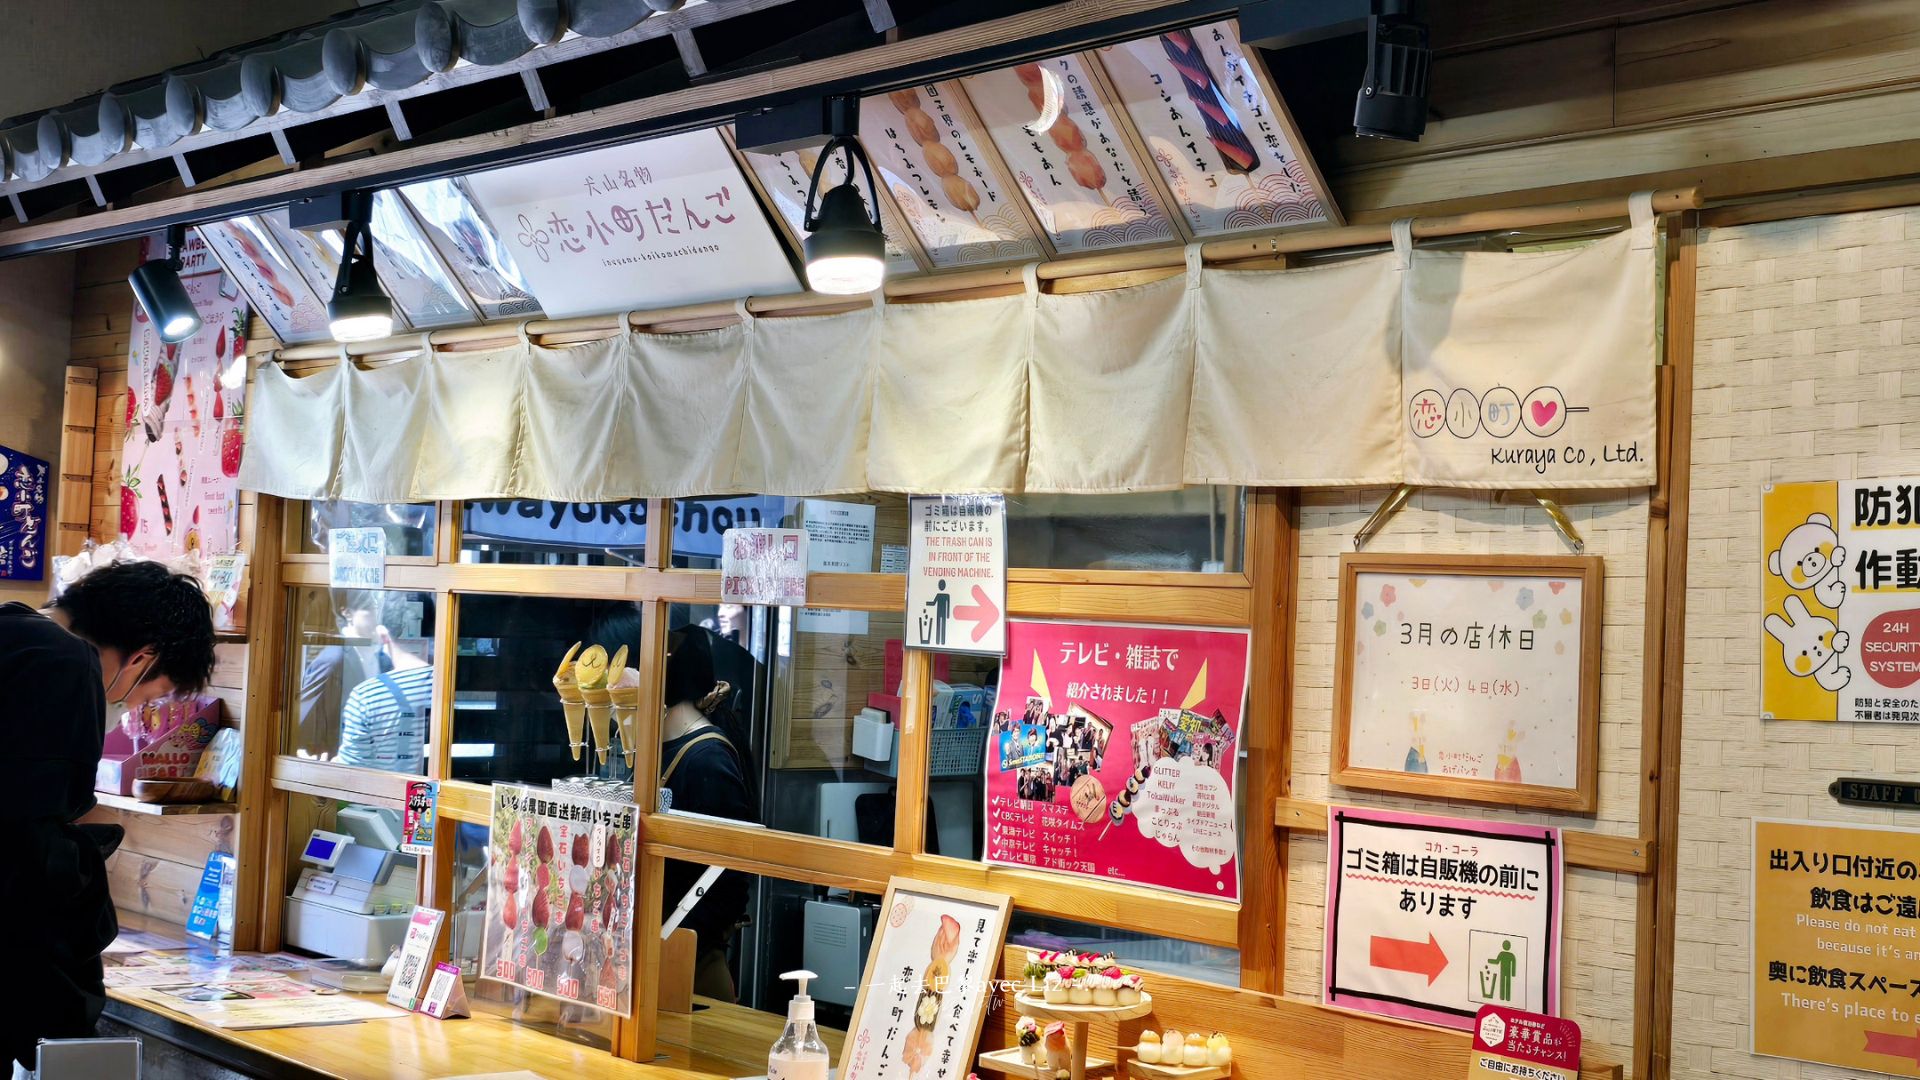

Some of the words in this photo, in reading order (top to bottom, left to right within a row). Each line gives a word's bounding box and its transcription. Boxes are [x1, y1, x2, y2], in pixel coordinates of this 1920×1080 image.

[1211, 27, 1302, 194] あんがイチゴに恋をした
[1150, 73, 1218, 188] コシあんイチゴ
[1022, 125, 1062, 187] ももあん
[584, 166, 653, 197] 犬山名物
[884, 127, 946, 223] はちみつレモン
[547, 186, 736, 253] 恋小町だんご
[1413, 398, 1515, 430] 恋小町
[1491, 446, 1556, 474] Kuraya
[1603, 441, 1645, 463] Ltd.
[925, 504, 992, 517] ゴミ箱は自販機の
[925, 521, 990, 532] 前にございます。
[925, 536, 940, 547] THE
[942, 537, 966, 547] TRASH
[968, 537, 984, 547] CAN
[985, 537, 992, 547] IS
[928, 552, 936, 562] IN
[938, 552, 962, 563] FRONT
[964, 552, 973, 563] OF
[975, 552, 990, 563] THE
[923, 567, 956, 578] VENDING
[957, 568, 994, 578] MACHINE.
[1400, 621, 1534, 650] 3月の店休日
[1883, 622, 1909, 634] 24H
[1060, 641, 1179, 671] テレビ・雑誌で
[1870, 661, 1920, 672] SYSTEM
[1153, 766, 1180, 778] GLITTER
[1850, 783, 1903, 802] STAFF
[500, 794, 632, 831] いなば農園直送新鮮いちご串
[1001, 811, 1035, 824] CBCテレビ
[1041, 803, 1068, 814] スマステ
[1151, 817, 1183, 830] ことりっぷ
[1155, 830, 1180, 842] じゃらん
[1425, 841, 1479, 857] コカ・コーラ
[1346, 847, 1539, 891] ゴミ箱は自販機の前に
[1770, 849, 1920, 880] 出入り口付近の
[1399, 888, 1477, 919] あります
[1810, 887, 1920, 919] 飲食はご遠
[1796, 914, 1840, 930] Please
[1844, 919, 1860, 932] do
[1865, 924, 1888, 935] not
[1893, 926, 1917, 938] eat
[1817, 937, 1872, 955] because
[1905, 950, 1920, 960] an
[496, 959, 516, 981] 500
[526, 967, 545, 990] 500
[596, 985, 617, 1009] 650
[1781, 992, 1839, 1013] There's
[1844, 1001, 1886, 1018] place
[1891, 1007, 1909, 1022] to
[1480, 1058, 1567, 1080] ご自由にお持ちください
